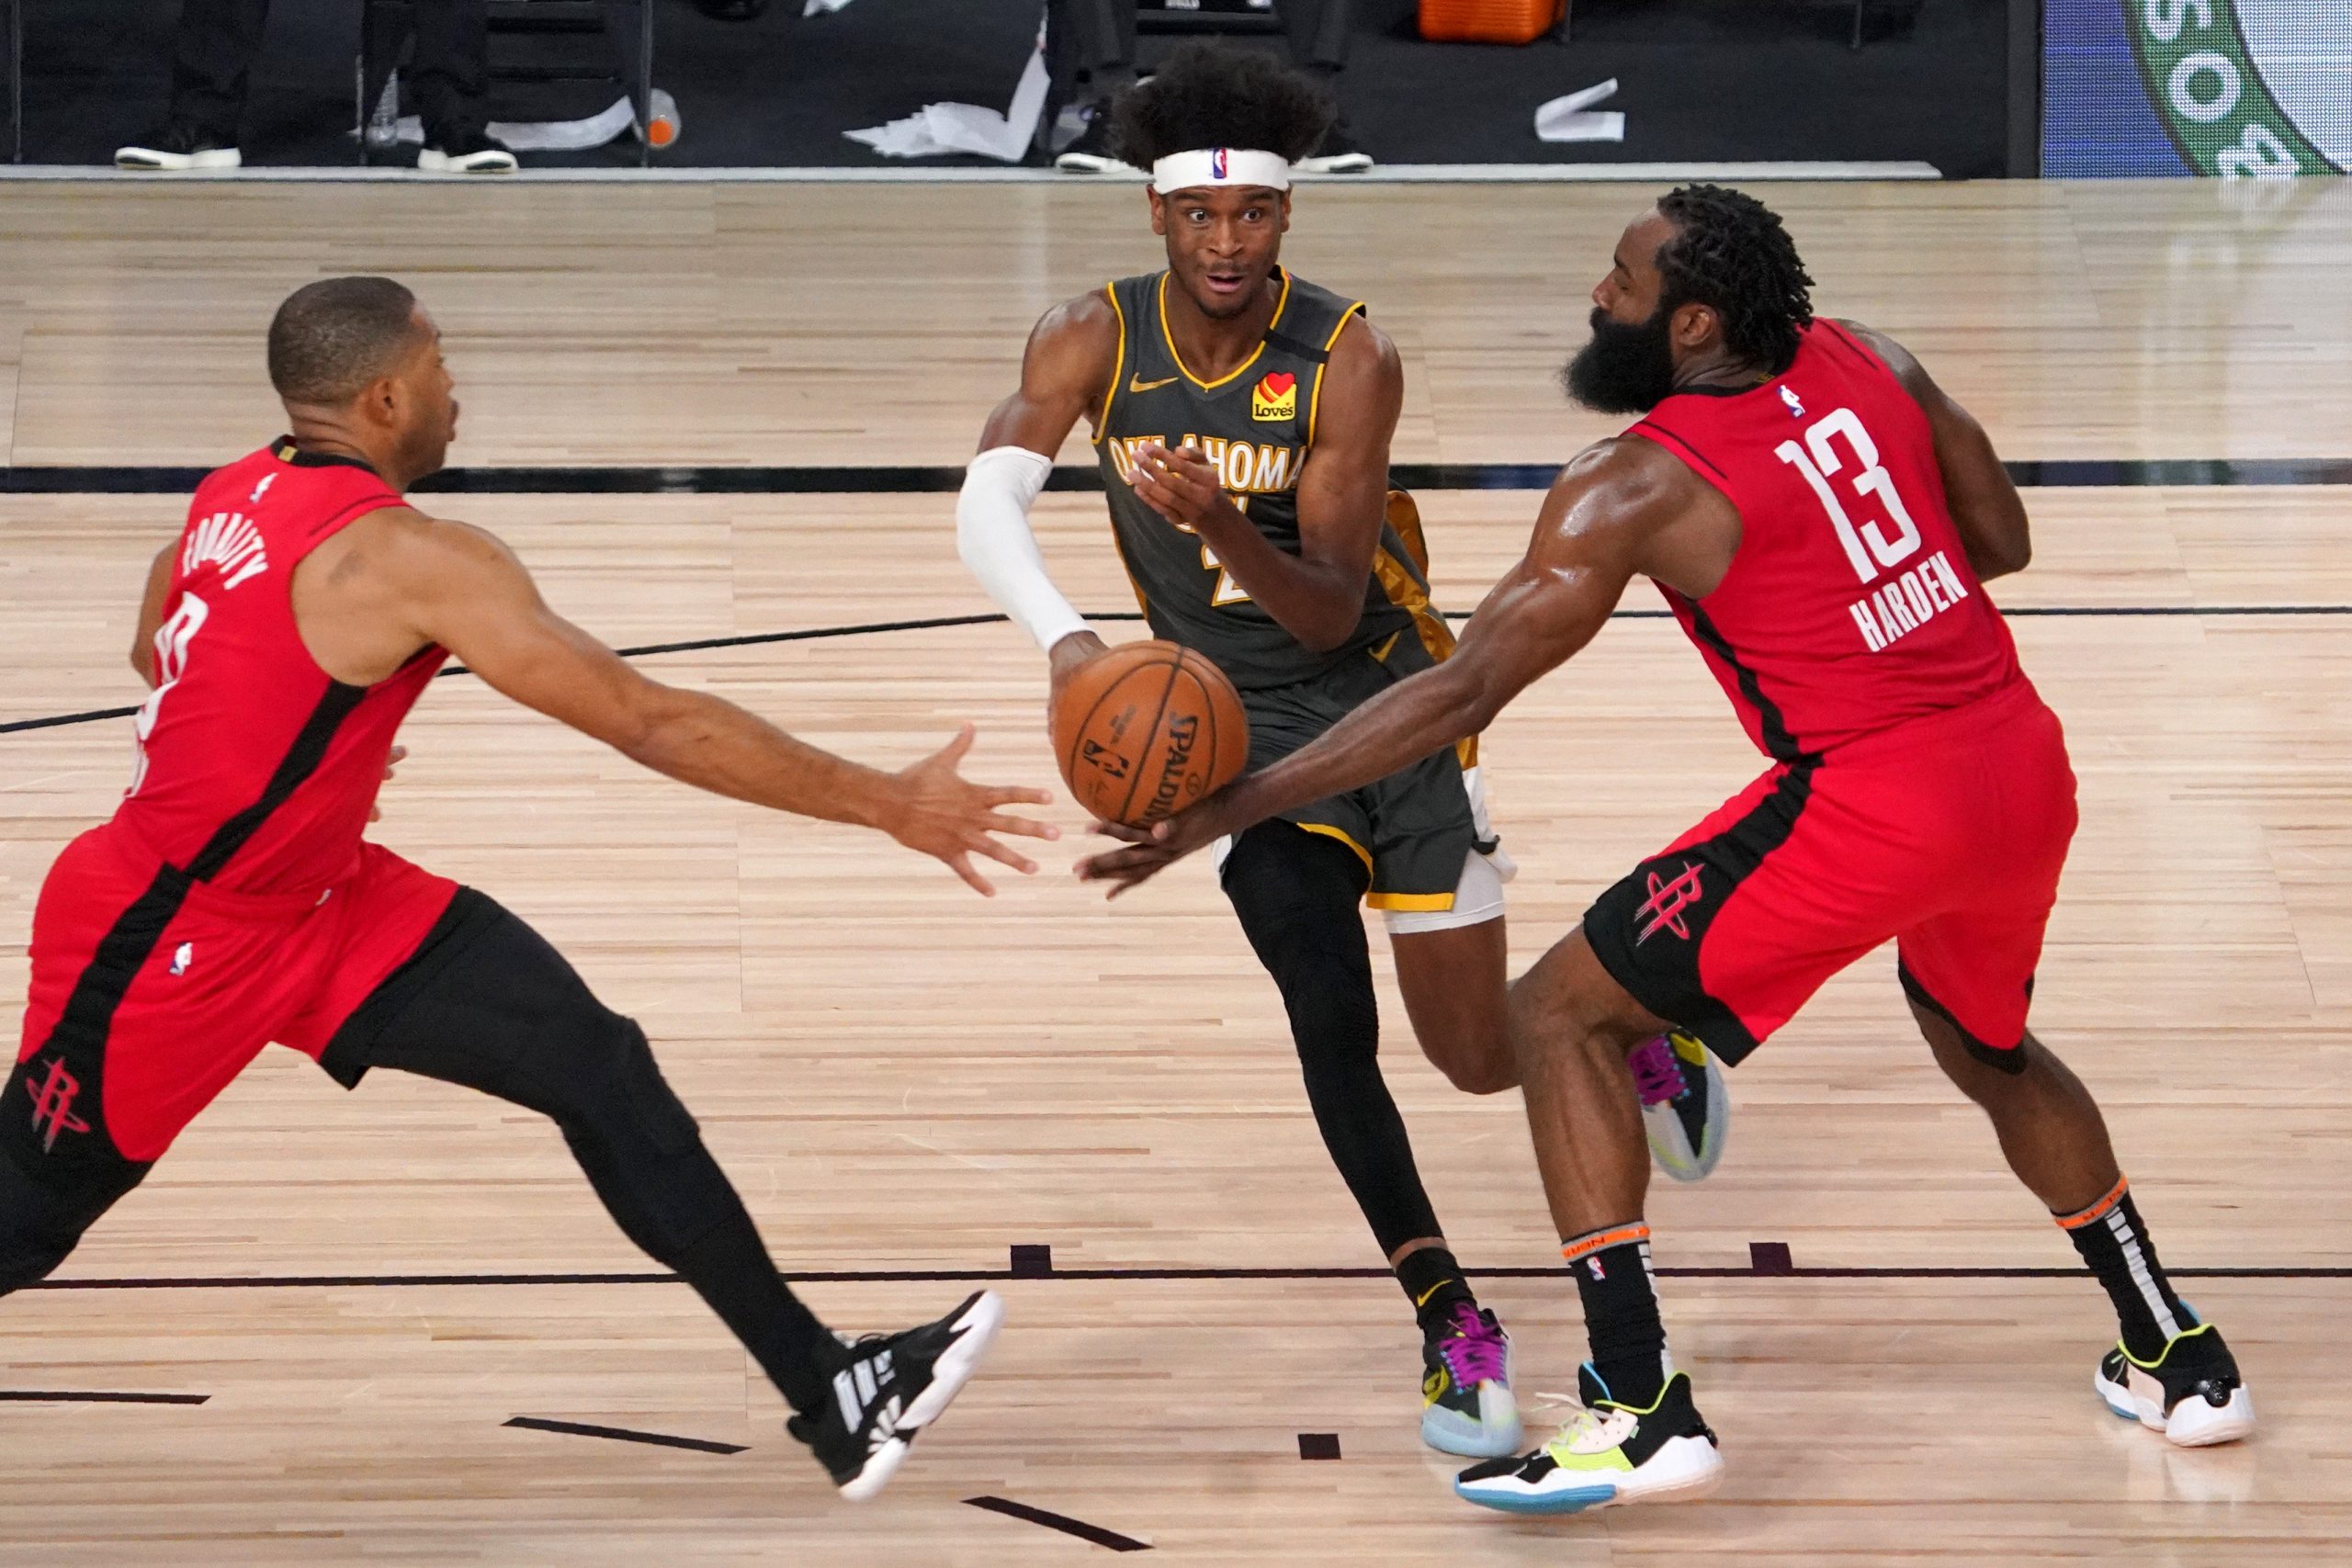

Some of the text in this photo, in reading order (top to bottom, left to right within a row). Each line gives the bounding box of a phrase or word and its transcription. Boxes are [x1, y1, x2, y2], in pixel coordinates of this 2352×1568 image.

[1255, 402, 1294, 418] Love's
[1773, 407, 1922, 584] 13
[1848, 550, 1969, 653] HARDEN
[1142, 711, 1199, 820] SPALDIN
